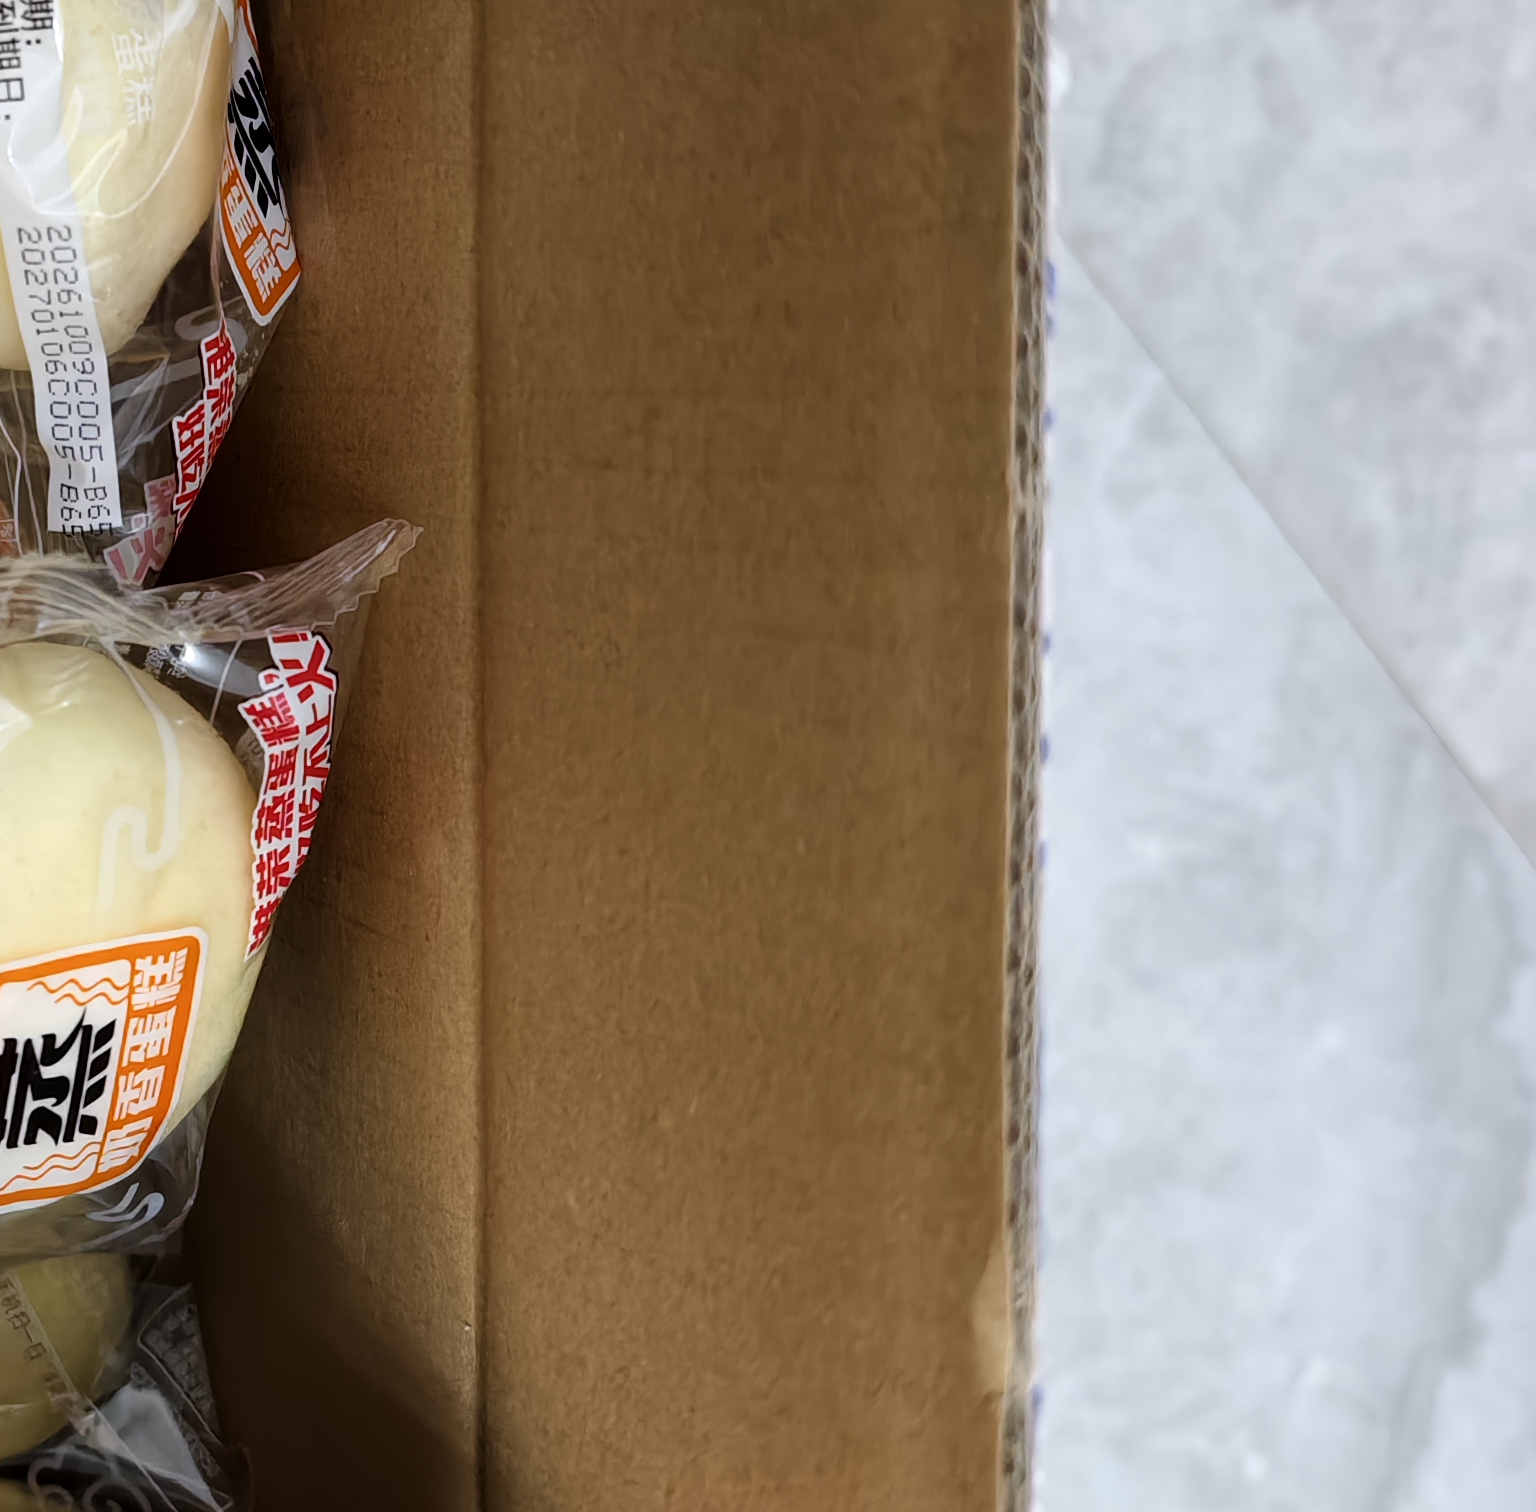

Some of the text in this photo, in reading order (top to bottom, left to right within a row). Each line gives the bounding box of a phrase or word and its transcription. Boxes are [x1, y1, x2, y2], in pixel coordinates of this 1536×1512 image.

[18, 227, 85, 537] 20270106C005-B65
[46, 225, 114, 536] 20261009C005-B65
[96, 948, 189, 1173] 奶香蛋糕
